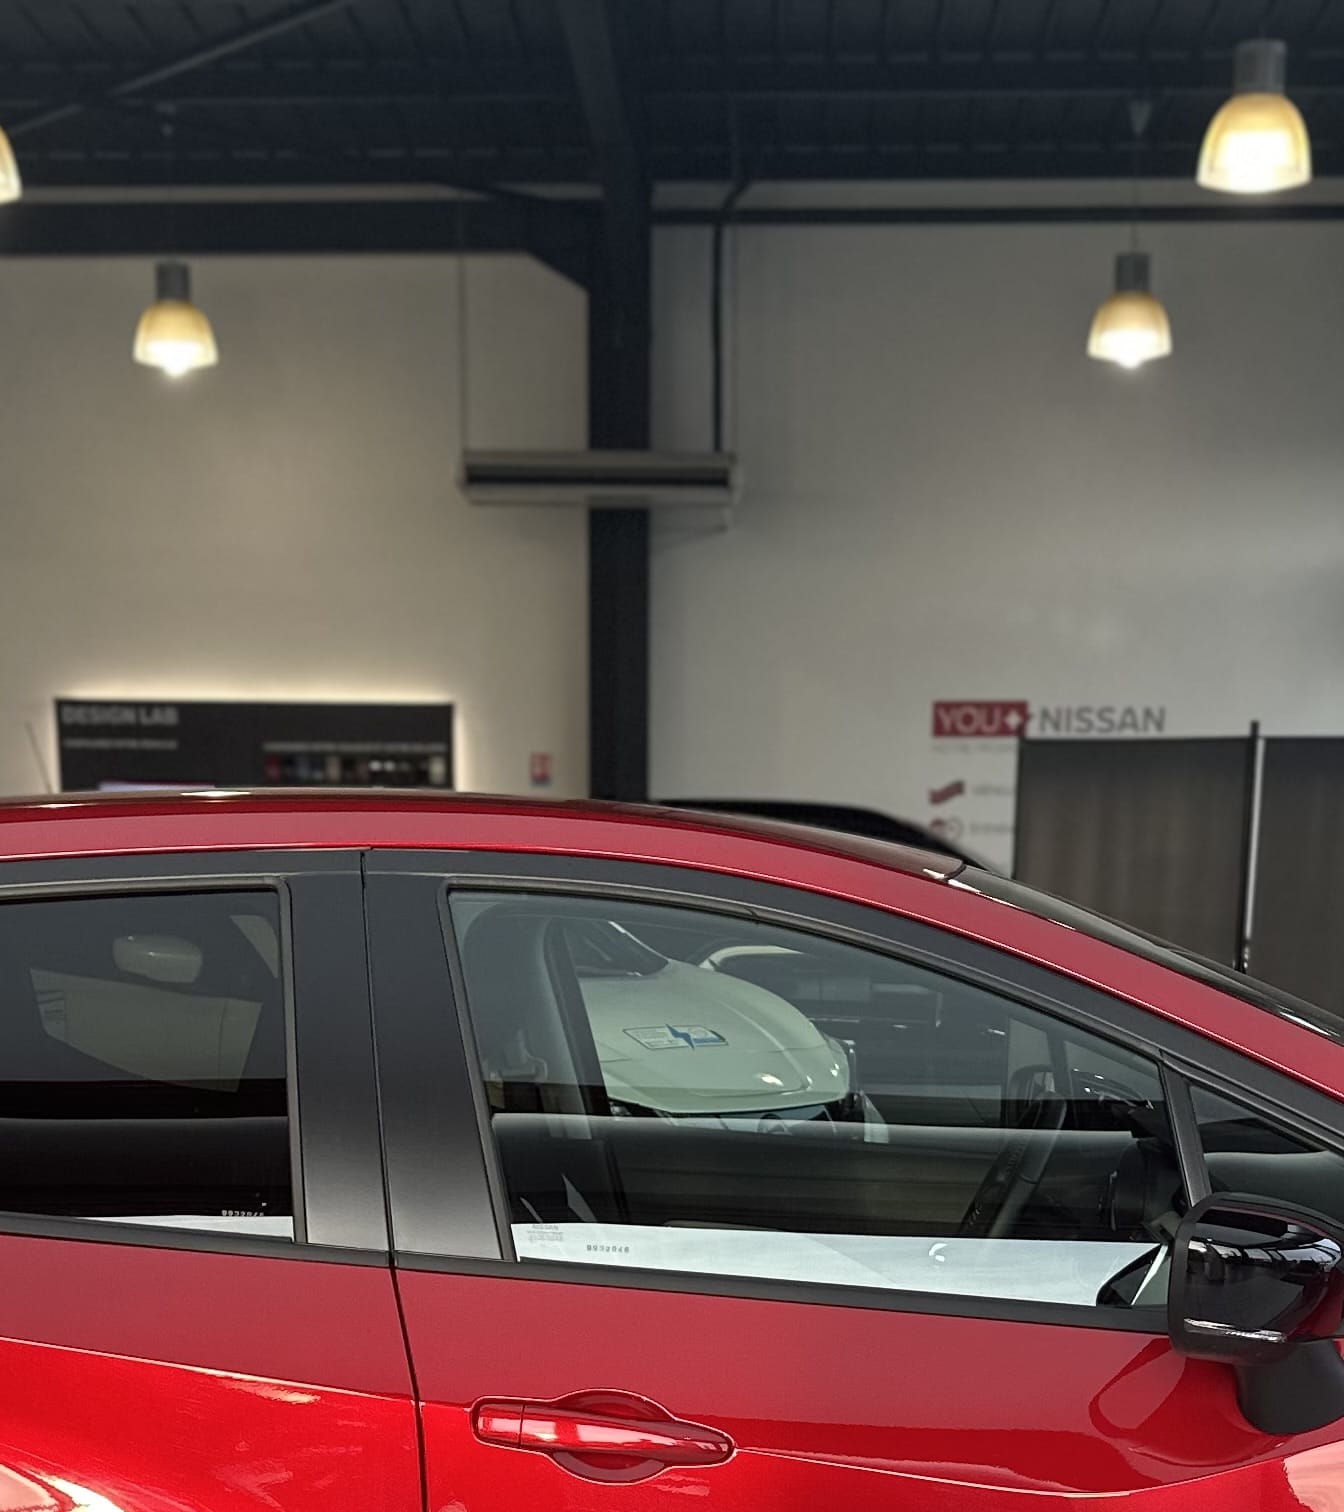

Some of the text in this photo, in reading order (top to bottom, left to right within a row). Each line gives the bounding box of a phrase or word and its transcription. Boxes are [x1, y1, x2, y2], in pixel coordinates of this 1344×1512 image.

[62, 706, 178, 725] DESIGN LAB
[1038, 706, 1167, 733] NISSAN
